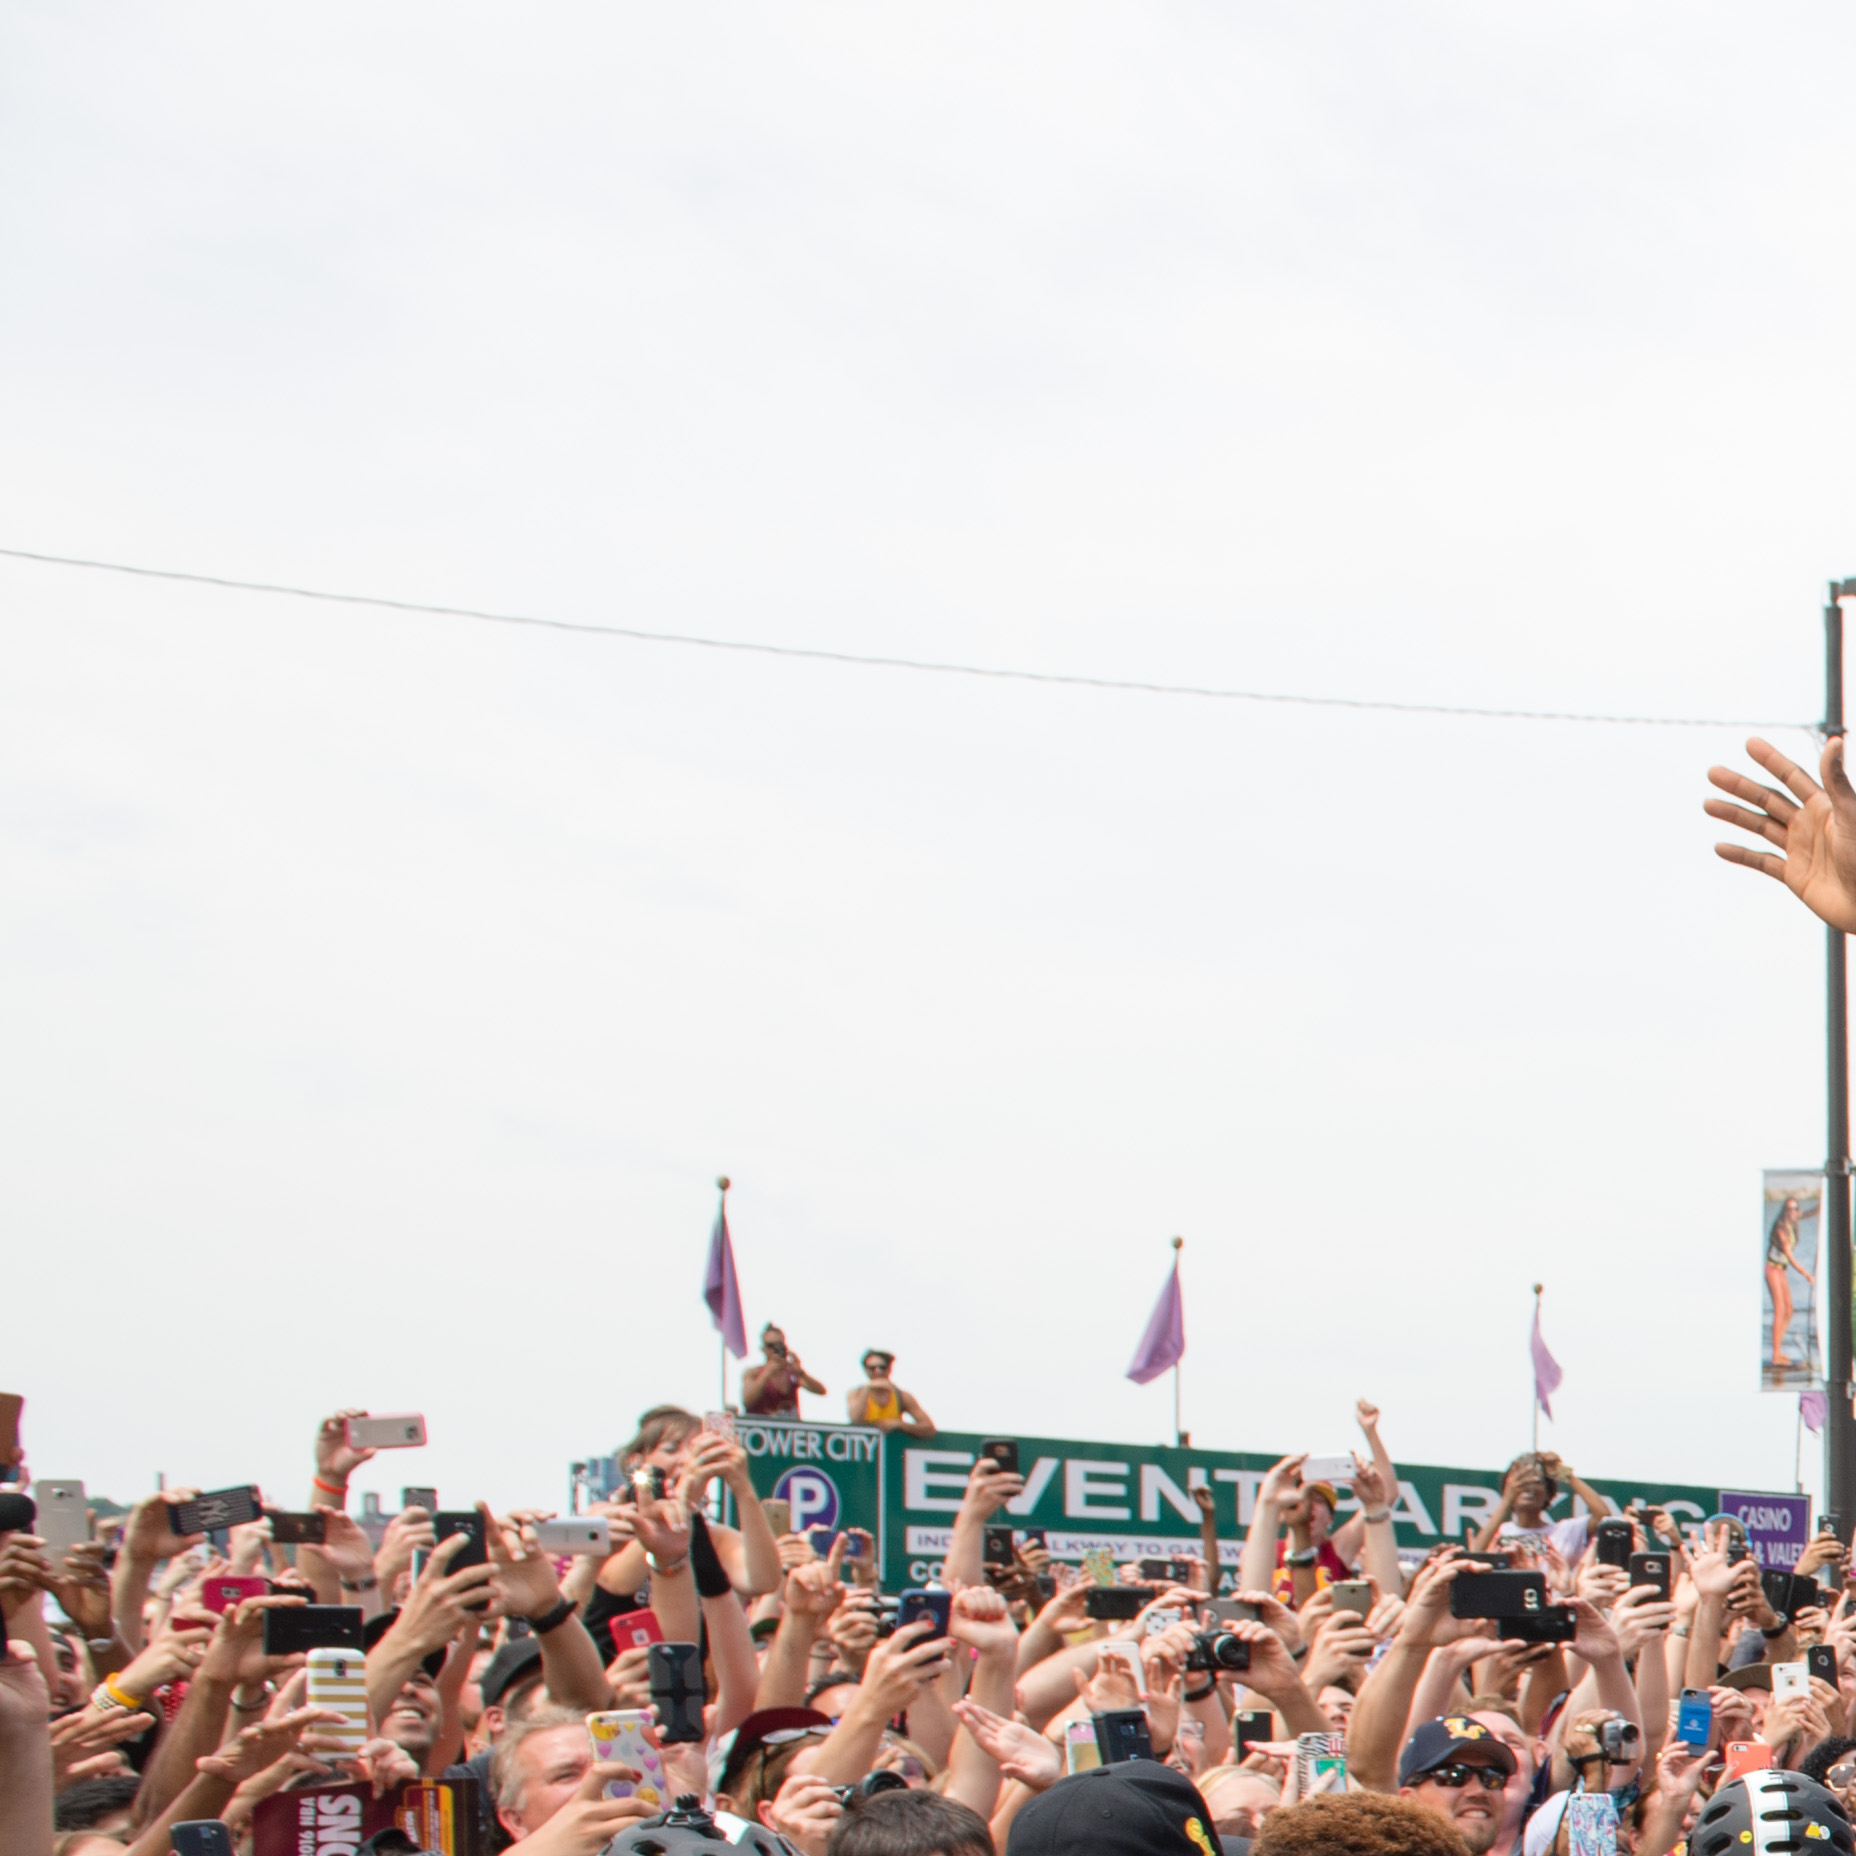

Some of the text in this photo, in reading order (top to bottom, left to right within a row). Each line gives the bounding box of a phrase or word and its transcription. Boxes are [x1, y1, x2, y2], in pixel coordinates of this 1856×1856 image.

[737, 1426, 878, 1463] TOWER CITY
[904, 1449, 1264, 1528] EVENT
[1737, 1505, 1793, 1532] CASINO
[299, 1796, 316, 1827] NBA
